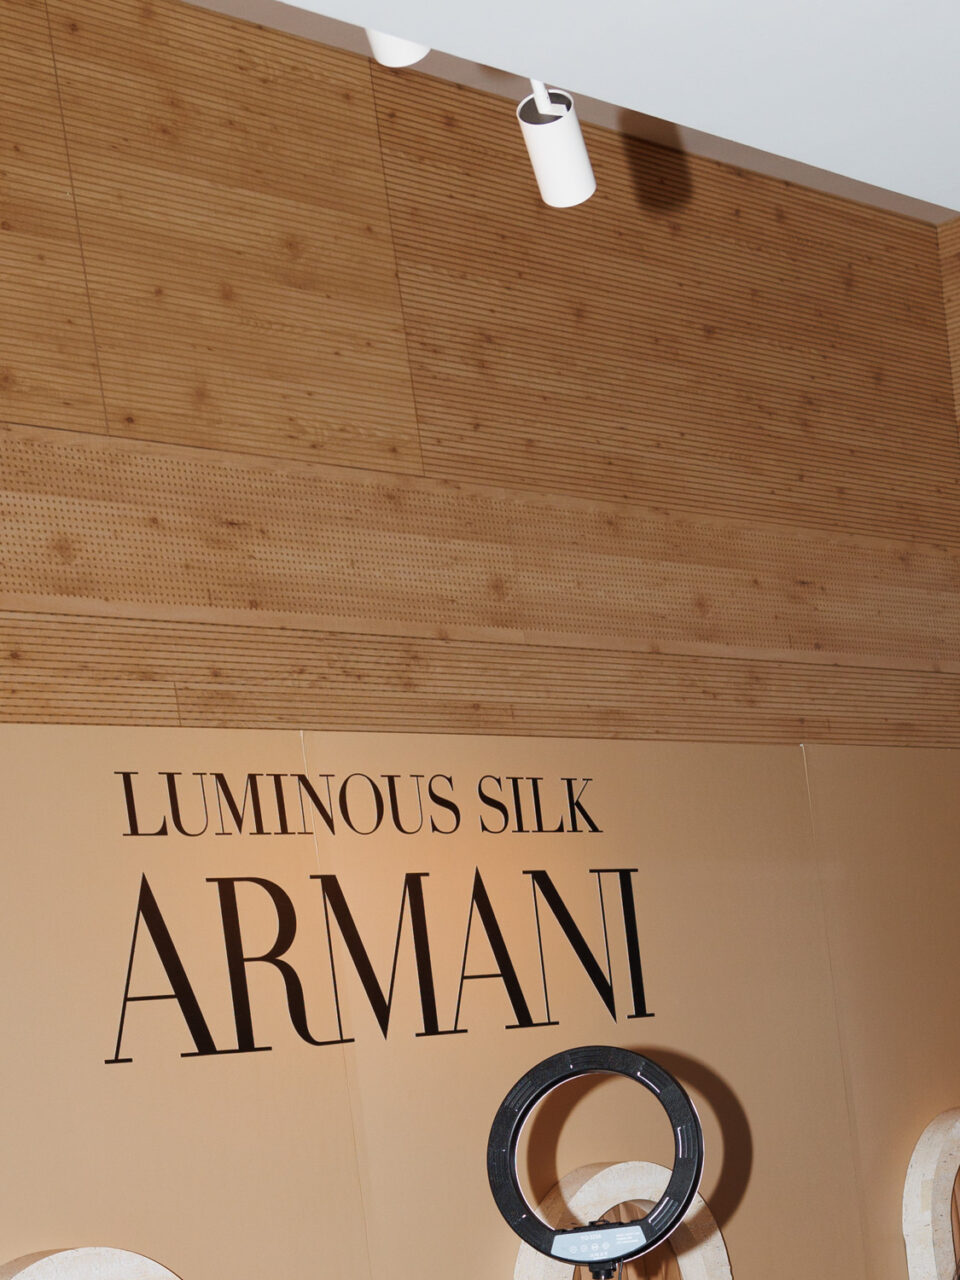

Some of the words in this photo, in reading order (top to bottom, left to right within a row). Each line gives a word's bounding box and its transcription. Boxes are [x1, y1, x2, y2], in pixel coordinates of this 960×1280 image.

[114, 771, 461, 837] LUMINOUS
[477, 775, 604, 834] SILK
[104, 866, 655, 1064] ARMANI
